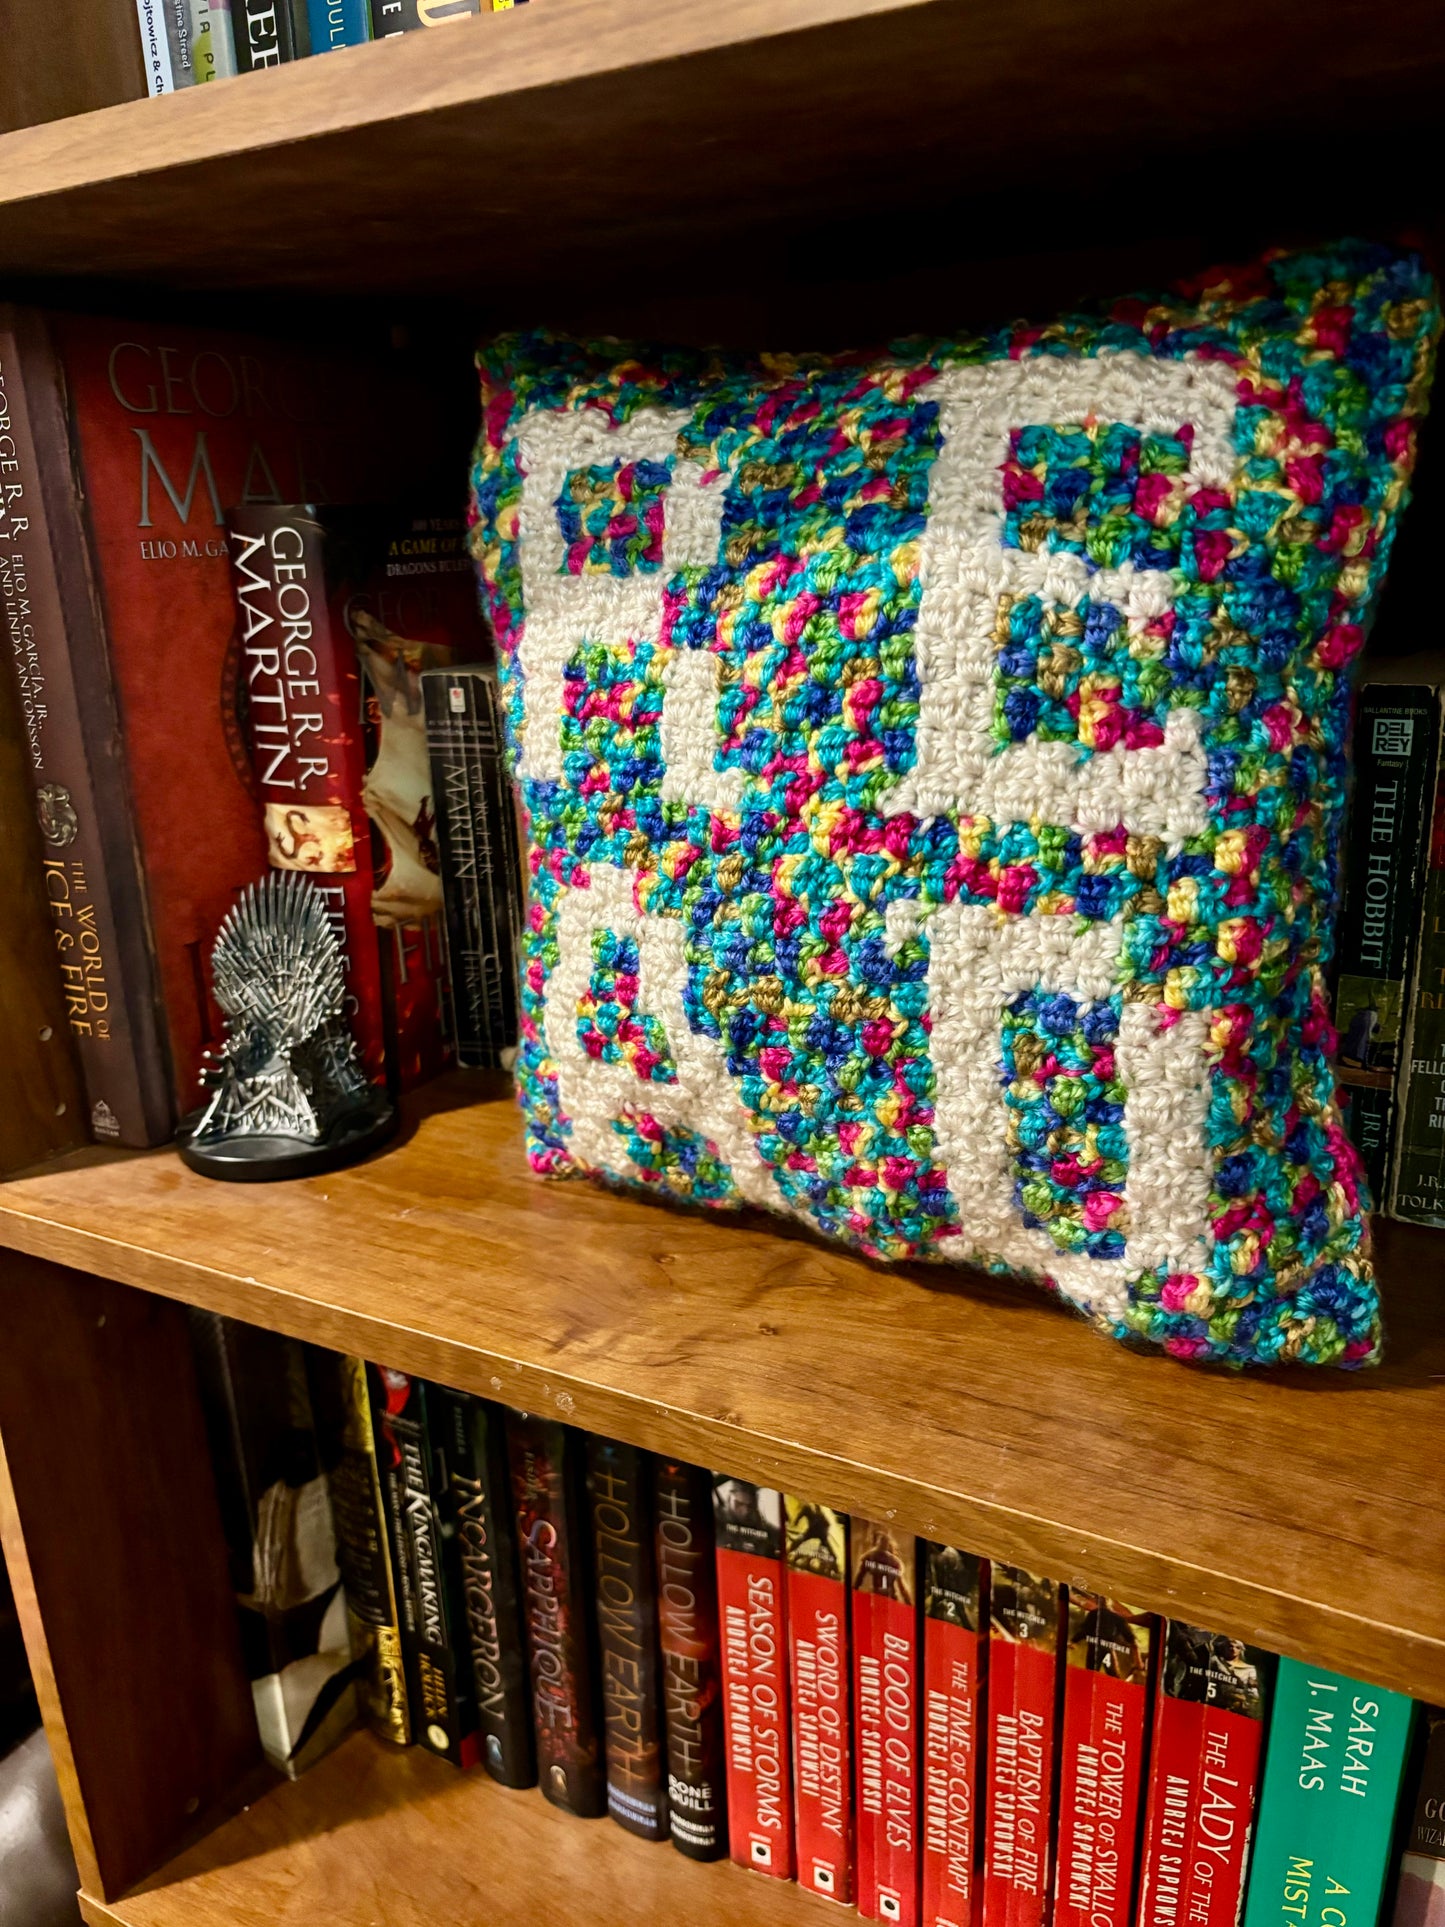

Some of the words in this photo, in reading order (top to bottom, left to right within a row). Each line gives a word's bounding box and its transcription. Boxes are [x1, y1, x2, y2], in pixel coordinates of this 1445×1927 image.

[152, 60, 161, 72] &
[155, 75, 164, 97] Ch
[5, 484, 23, 509] R.
[10, 516, 29, 541] R.
[11, 554, 28, 593] ELIO
[140, 539, 176, 561] ELIO
[270, 525, 321, 701] GEORGE
[6, 602, 24, 656] LINDA
[16, 662, 44, 770] ANTONSSON
[229, 531, 297, 791] MARTIN
[291, 711, 324, 748] R.
[1375, 737, 1411, 753] REY
[1377, 721, 1412, 737] DEL
[297, 756, 330, 791] R.
[443, 763, 478, 879] MARTIN
[1370, 779, 1399, 844] THE
[42, 859, 73, 919] ICE
[71, 861, 88, 895] THE
[54, 928, 75, 951] &
[1358, 853, 1392, 970] HOBBIT
[75, 904, 108, 1014] WORLD
[60, 963, 93, 1038] FIRE
[403, 1442, 425, 1490] THE
[404, 1486, 445, 1647] KINGMAKING
[593, 1465, 643, 1650] HOLLOW
[658, 1488, 706, 1649] HOLLOW
[881, 1574, 888, 1590] 1
[450, 1470, 506, 1721] INCARCERON
[515, 1511, 574, 1729] SAPPHIQUE
[747, 1572, 776, 1679] SEASON
[946, 1601, 956, 1617] 2
[1003, 1607, 1015, 1617] THE
[1016, 1610, 1046, 1626] WITCHER
[725, 1605, 749, 1678] ANDRZEJ
[815, 1609, 840, 1701] SWORD
[1019, 1622, 1029, 1639] 3
[1086, 1634, 1099, 1645] THE
[1100, 1637, 1131, 1656] WITCHER
[1102, 1652, 1112, 1669] 4
[752, 1683, 778, 1723] OF
[796, 1637, 817, 1708] ANDRZEJ
[860, 1654, 881, 1725] ANDRZEJ
[883, 1631, 911, 1732] BLOOD
[951, 1660, 969, 1693] THE
[1189, 1665, 1203, 1677] THE
[1204, 1668, 1239, 1686] WITCHER
[1206, 1681, 1218, 1699] 5
[1306, 1679, 1340, 1697] J.
[605, 1649, 646, 1786] EARTH
[664, 1650, 704, 1777] EARTH
[729, 1681, 753, 1773] SAPKOWSKI
[818, 1705, 841, 1741] OF
[928, 1689, 949, 1763] ANDRZEJ
[950, 1694, 972, 1753] TIME
[1104, 1701, 1124, 1735] THE
[753, 1724, 782, 1831] STORMS
[798, 1711, 820, 1798] SAPKOWSKI
[861, 1728, 882, 1815] SAPKOWSKI
[884, 1737, 911, 1779] OF
[950, 1751, 967, 1776] OF
[994, 1713, 1019, 1786] ANDRZEJ
[1016, 1709, 1044, 1814] BAPTISM
[1097, 1738, 1127, 1821] TOWER
[1205, 1731, 1229, 1769] THE
[1298, 1707, 1336, 1792] MAAS
[1339, 1696, 1381, 1799] SARAH
[668, 1773, 713, 1799] BONE
[668, 1786, 715, 1812] QUILL
[819, 1741, 844, 1839] DESTINY
[927, 1765, 948, 1855] SAPKOWSKI
[1073, 1743, 1100, 1818] ANDRZEJ
[1160, 1774, 1191, 1849] ANDRZEJ
[885, 1779, 912, 1852] ELVES
[948, 1776, 972, 1900] CONTEMPT
[992, 1790, 1016, 1880] SAPKOWSKI
[1017, 1817, 1036, 1845] OF
[1098, 1821, 1116, 1847] OF
[1196, 1770, 1239, 1865] LADY
[1013, 1846, 1039, 1897] FIRE
[1068, 1820, 1096, 1911] SAPKOWSKI
[1193, 1860, 1215, 1889] OF
[1281, 1855, 1315, 1920] MIST
[1324, 1875, 1352, 1895] A
[1188, 1891, 1212, 1926] THE
